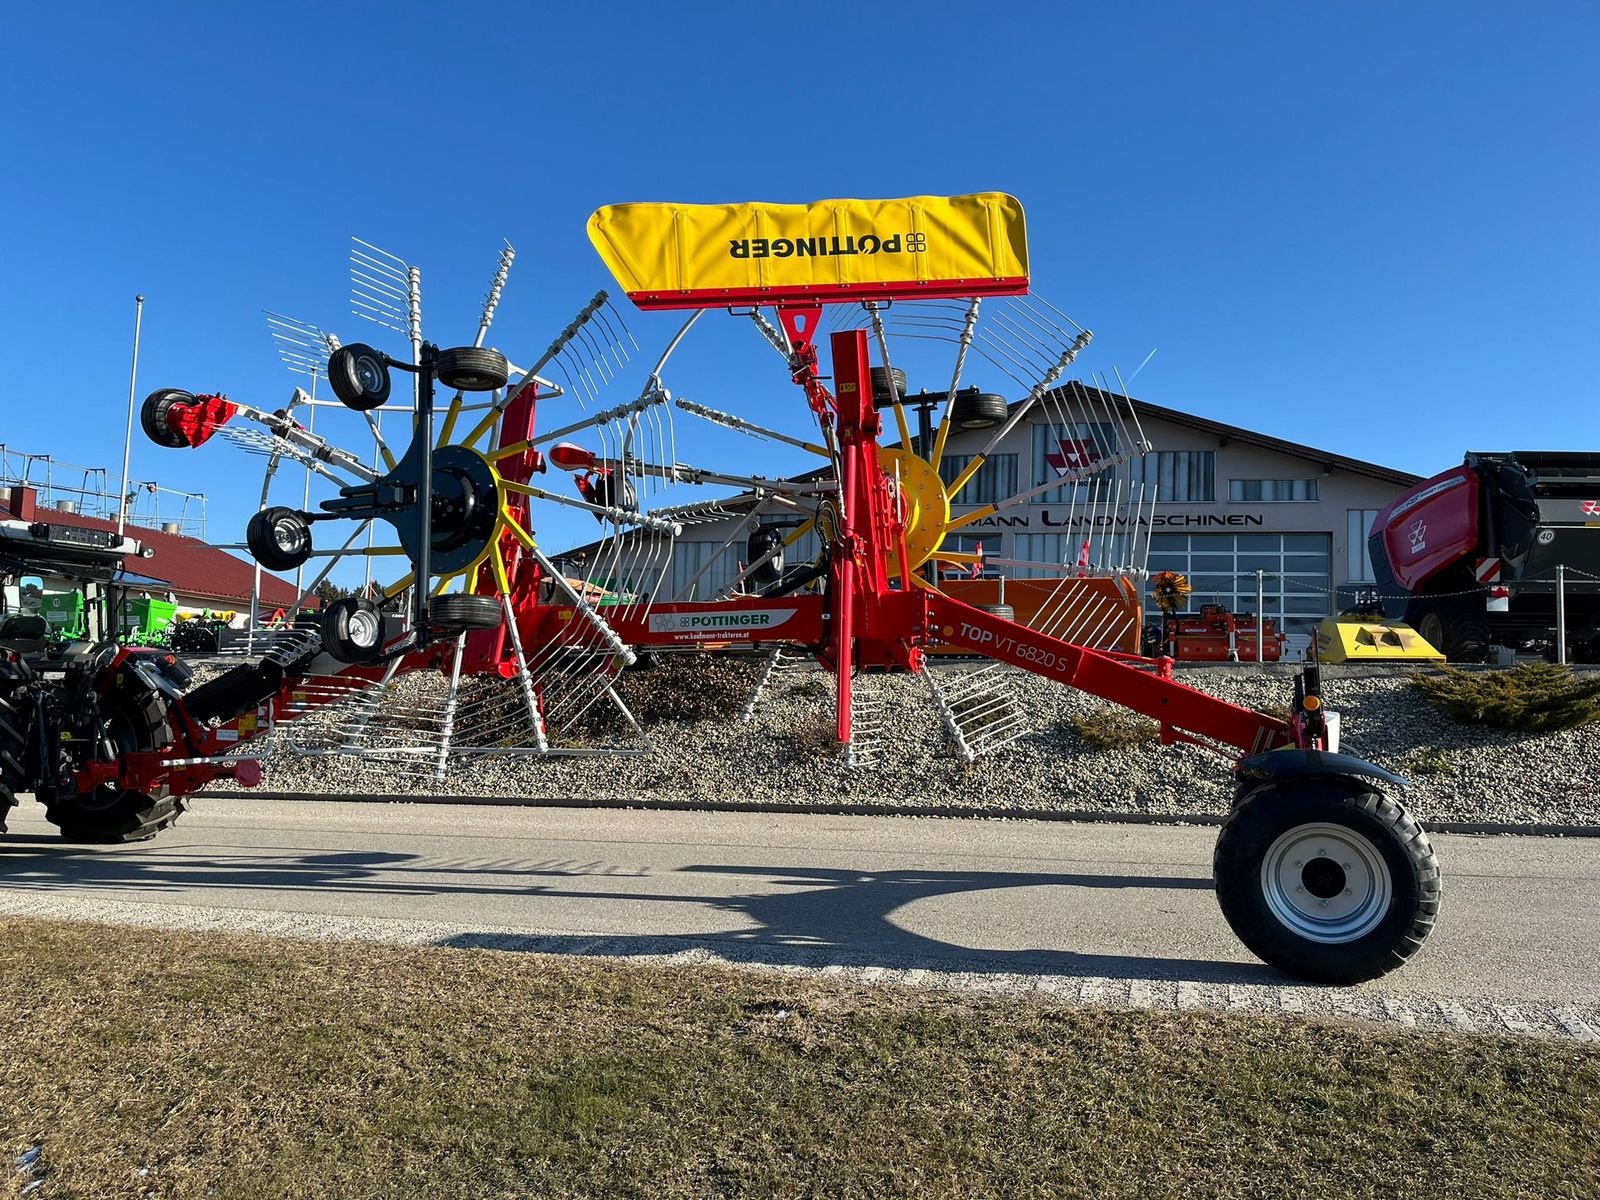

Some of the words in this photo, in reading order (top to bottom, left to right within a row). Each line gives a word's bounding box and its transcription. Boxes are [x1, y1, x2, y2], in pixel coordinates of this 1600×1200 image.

[951, 516, 1029, 527] MANN
[1540, 532, 1553, 541] 40
[960, 622, 993, 643] TOP
[995, 634, 1017, 653] VT
[1015, 643, 1056, 667] 6820
[1056, 657, 1068, 672] S
